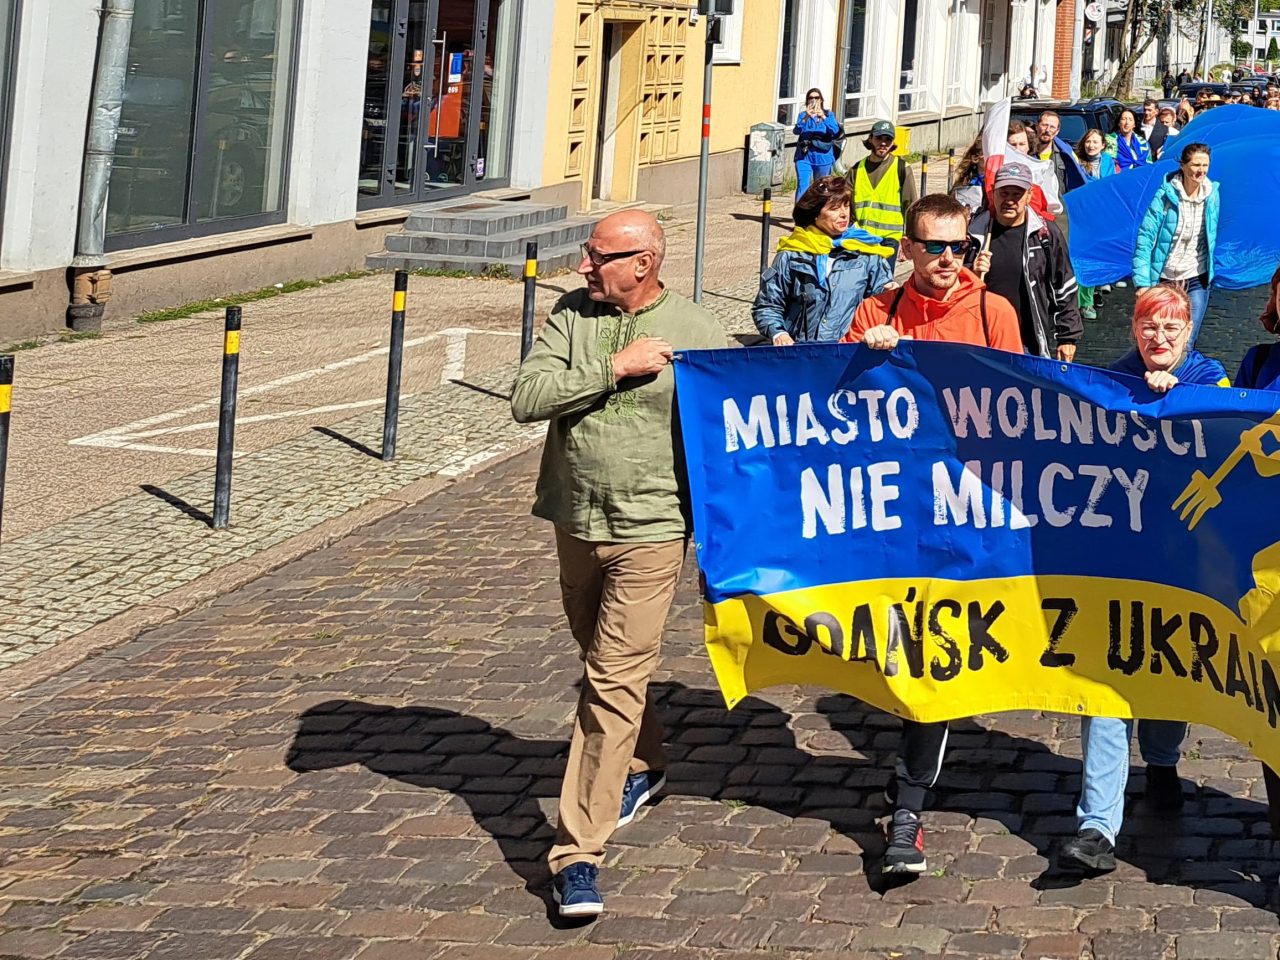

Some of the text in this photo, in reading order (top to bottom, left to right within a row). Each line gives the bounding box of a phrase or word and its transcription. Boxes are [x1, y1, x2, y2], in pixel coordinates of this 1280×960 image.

[722, 387, 919, 452] MIASTO
[801, 460, 1149, 539] NIE MILCZY
[762, 586, 1010, 682] GDAŃSK
[1040, 598, 1078, 667] Z
